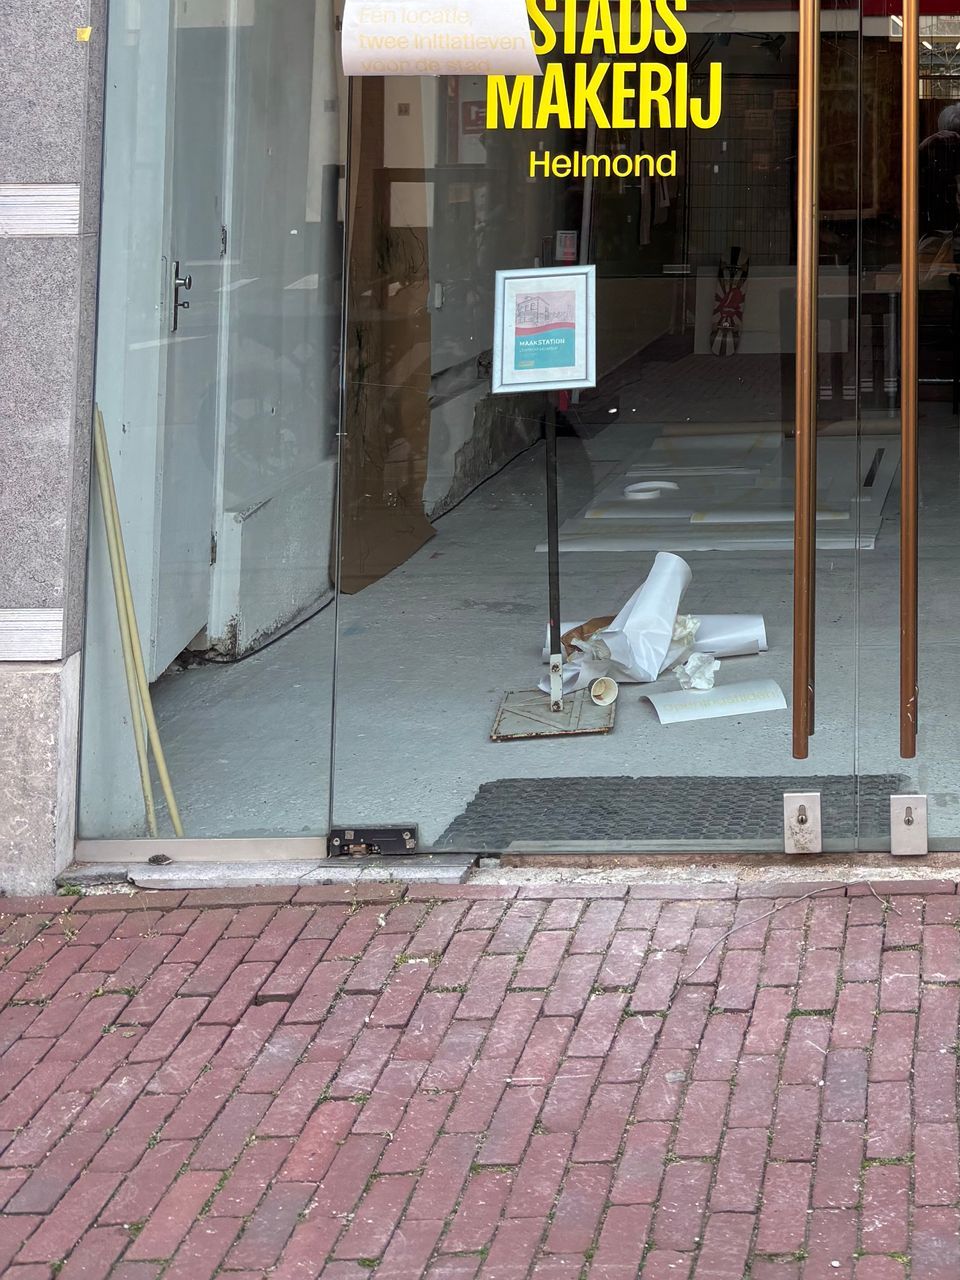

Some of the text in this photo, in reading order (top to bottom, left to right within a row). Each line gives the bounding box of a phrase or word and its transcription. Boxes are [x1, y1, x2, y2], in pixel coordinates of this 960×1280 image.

[358, 33, 409, 49] twee
[486, 62, 723, 129] MAKERIJ
[529, 150, 677, 178] Helmond
